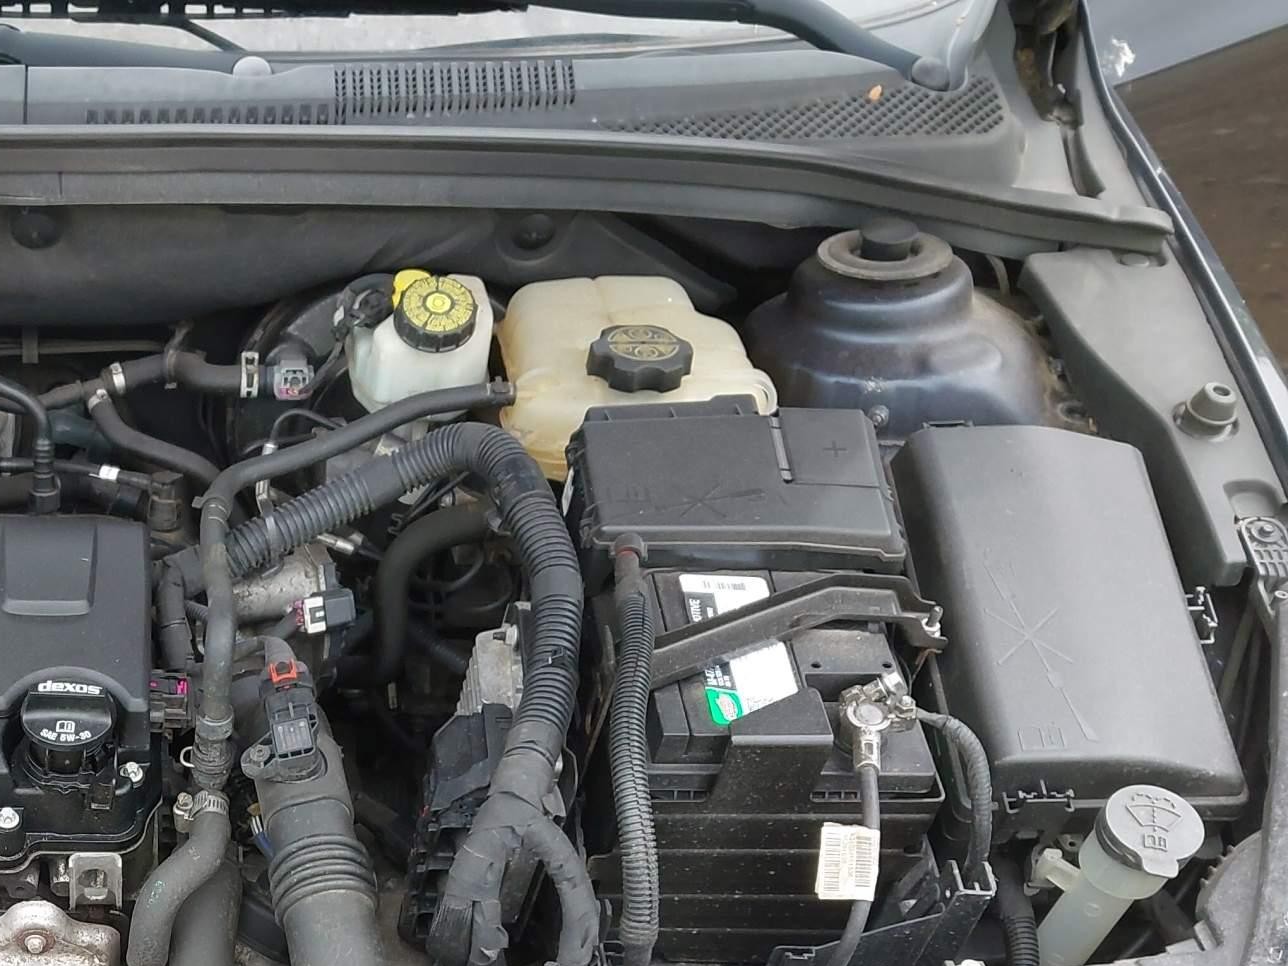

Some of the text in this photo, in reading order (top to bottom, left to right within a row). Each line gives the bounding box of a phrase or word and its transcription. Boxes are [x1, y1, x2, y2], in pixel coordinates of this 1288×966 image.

[37, 680, 103, 695] dexos
[40, 728, 92, 742] SAE 5W-30
